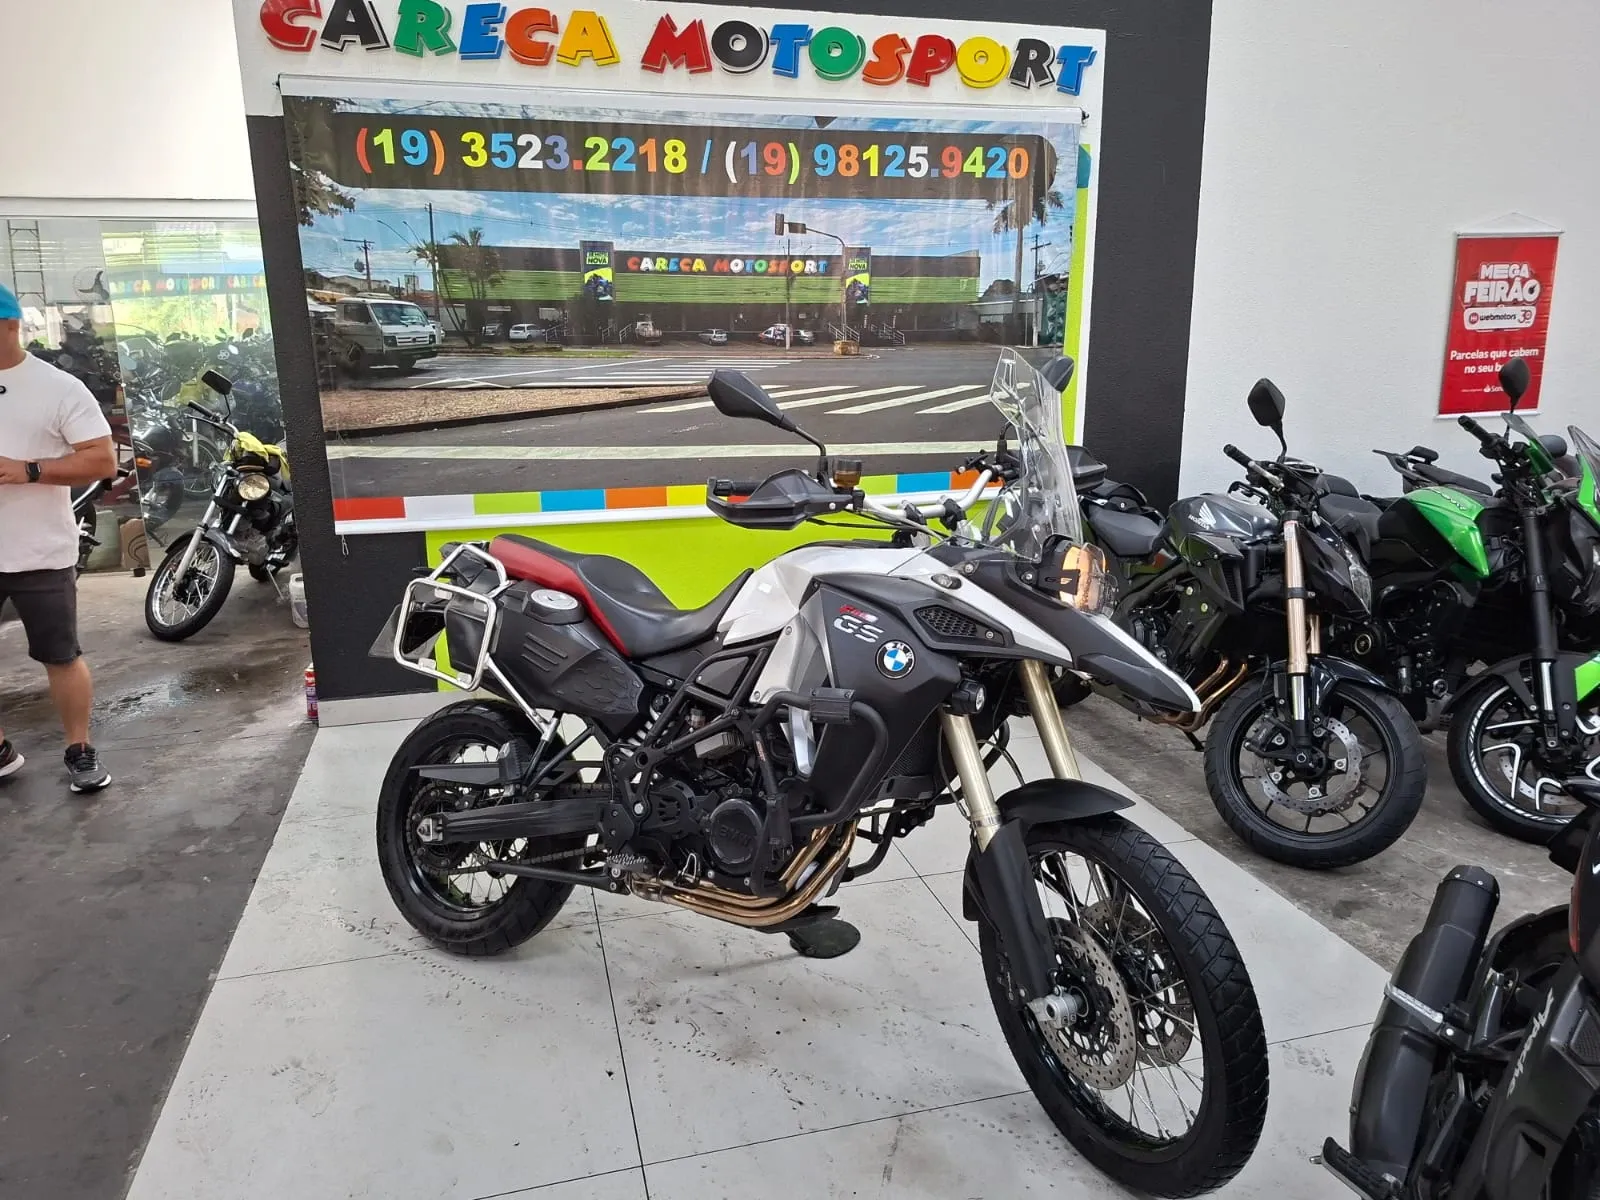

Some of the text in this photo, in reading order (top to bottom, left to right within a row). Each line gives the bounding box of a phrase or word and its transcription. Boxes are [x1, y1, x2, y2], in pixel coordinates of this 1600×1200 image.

[259, 0, 1098, 96] CARECA MOTOSPORT
[355, 127, 1030, 185] (19) 3523.2218 / (19) 98125.9420
[627, 256, 828, 274] CARECA MOTOSPORT
[1480, 263, 1530, 279] MEGA
[1463, 277, 1541, 304] FEIRÃO
[1479, 309, 1533, 324] webmotors 30
[1450, 347, 1539, 361] Parcelas que cabem
[1464, 365, 1476, 374] no
[1477, 364, 1494, 373] seu
[1187, 513, 1211, 531] HONDA
[833, 614, 885, 643] GS
